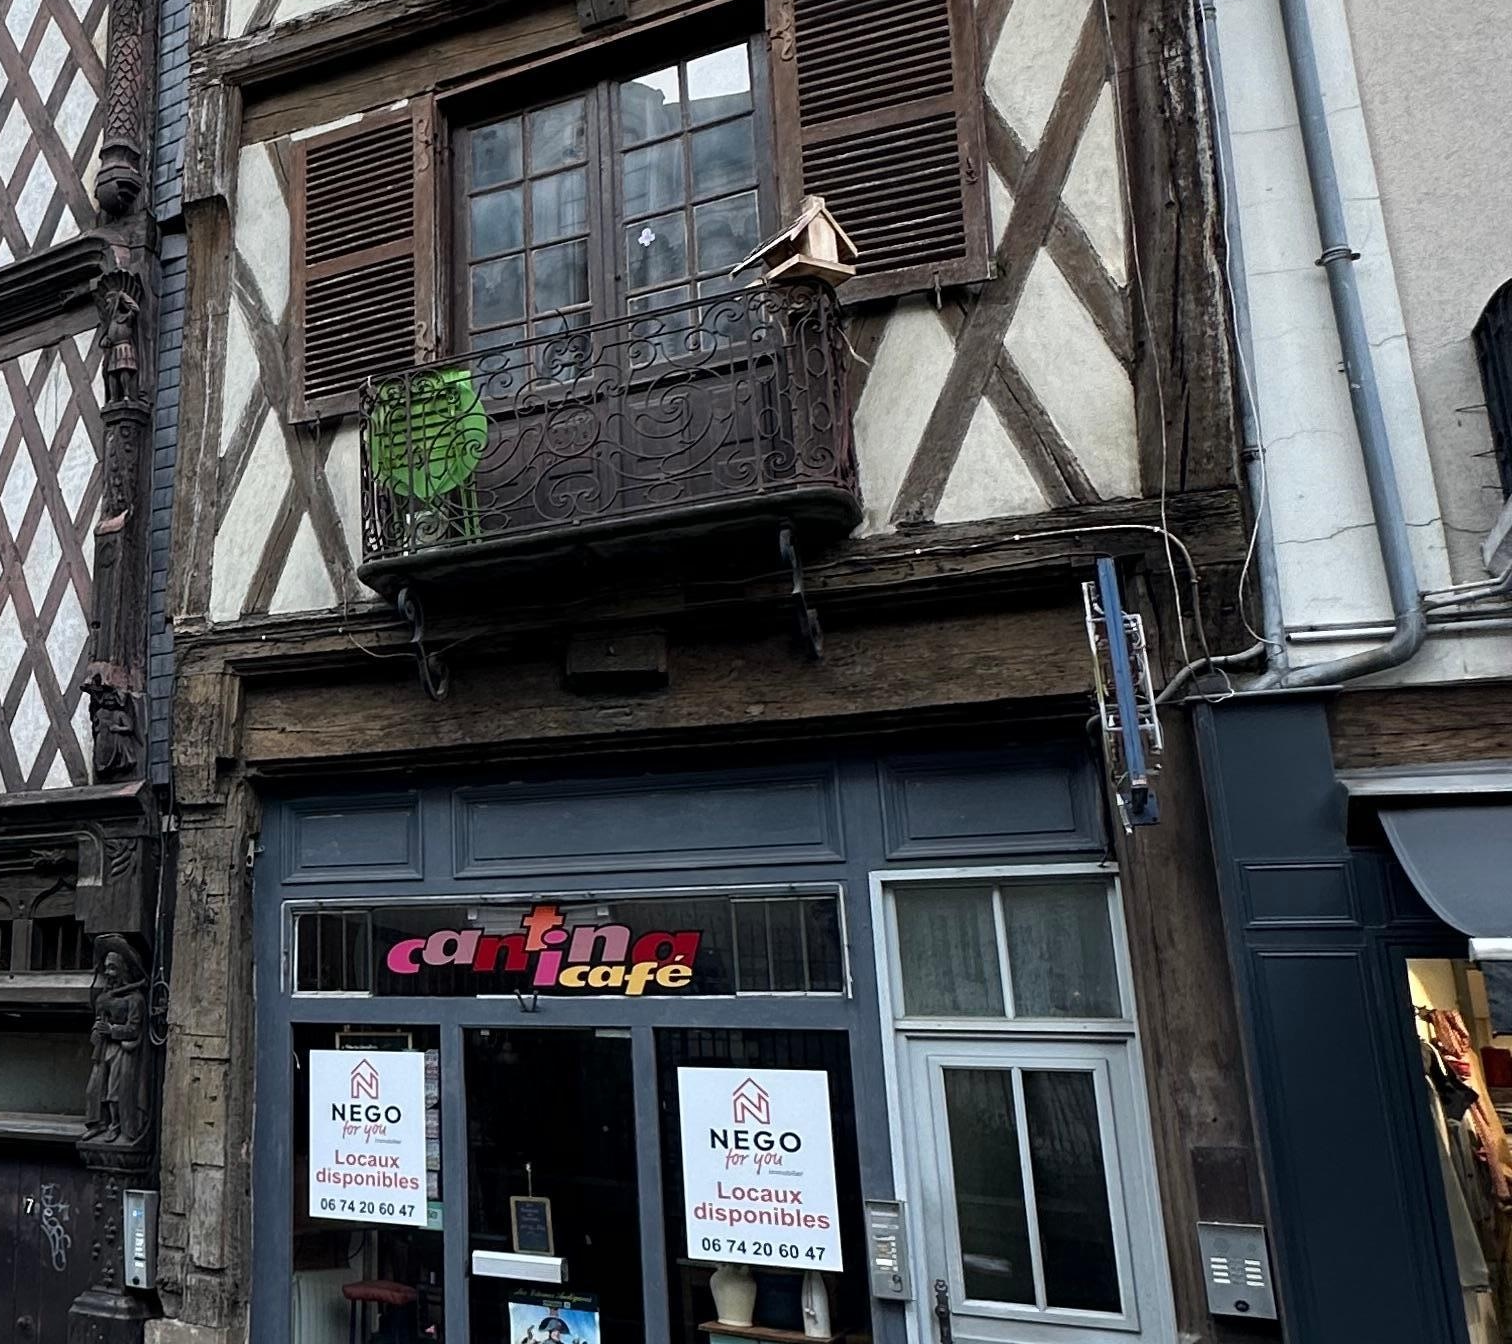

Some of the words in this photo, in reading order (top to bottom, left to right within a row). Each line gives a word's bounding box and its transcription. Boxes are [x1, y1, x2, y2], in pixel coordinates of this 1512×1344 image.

[387, 905, 702, 987] cantina
[559, 955, 693, 995] café
[332, 1103, 401, 1123] NEGO
[342, 1120, 361, 1139] for
[364, 1123, 387, 1144] you
[710, 1128, 801, 1152] NEGO
[335, 1150, 400, 1168] Locaux
[725, 1148, 749, 1170] for
[754, 1152, 783, 1175] you
[316, 1168, 419, 1190] disponibles
[717, 1181, 803, 1204] Locaux
[26, 1198, 34, 1214] 7
[320, 1198, 336, 1211] 06
[340, 1199, 355, 1212] 74
[359, 1201, 374, 1214] 20
[379, 1203, 395, 1215] 60
[399, 1205, 415, 1217] 47
[694, 1202, 830, 1229] disponibles
[702, 1237, 721, 1252] 06
[726, 1239, 746, 1254] 74
[752, 1242, 772, 1257] 20
[779, 1244, 799, 1259] 60
[805, 1246, 825, 1261] 47
